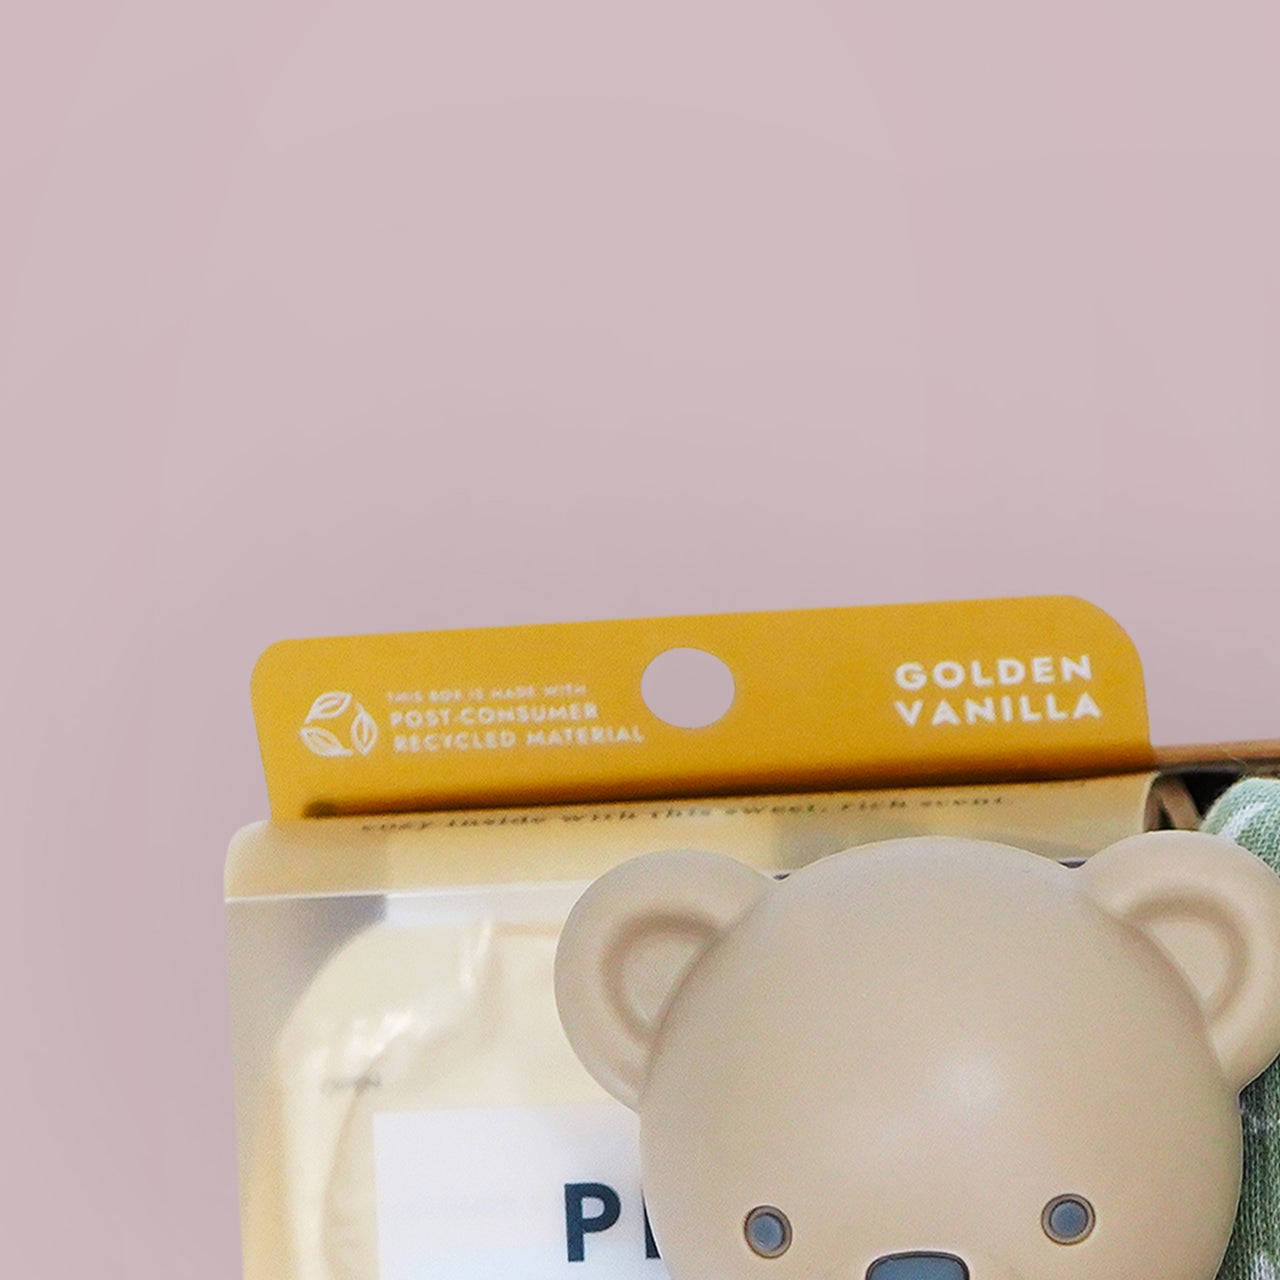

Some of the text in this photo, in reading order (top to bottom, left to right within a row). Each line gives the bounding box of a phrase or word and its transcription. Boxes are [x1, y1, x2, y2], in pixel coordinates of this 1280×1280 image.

[894, 654, 1092, 692] GOLDEN
[387, 683, 587, 703] THIS BOX IS MADE WITH
[390, 702, 599, 728] POST-CONSUMER
[893, 691, 1102, 727] VANILLA
[394, 725, 645, 753] RECYCLED MATERIAL
